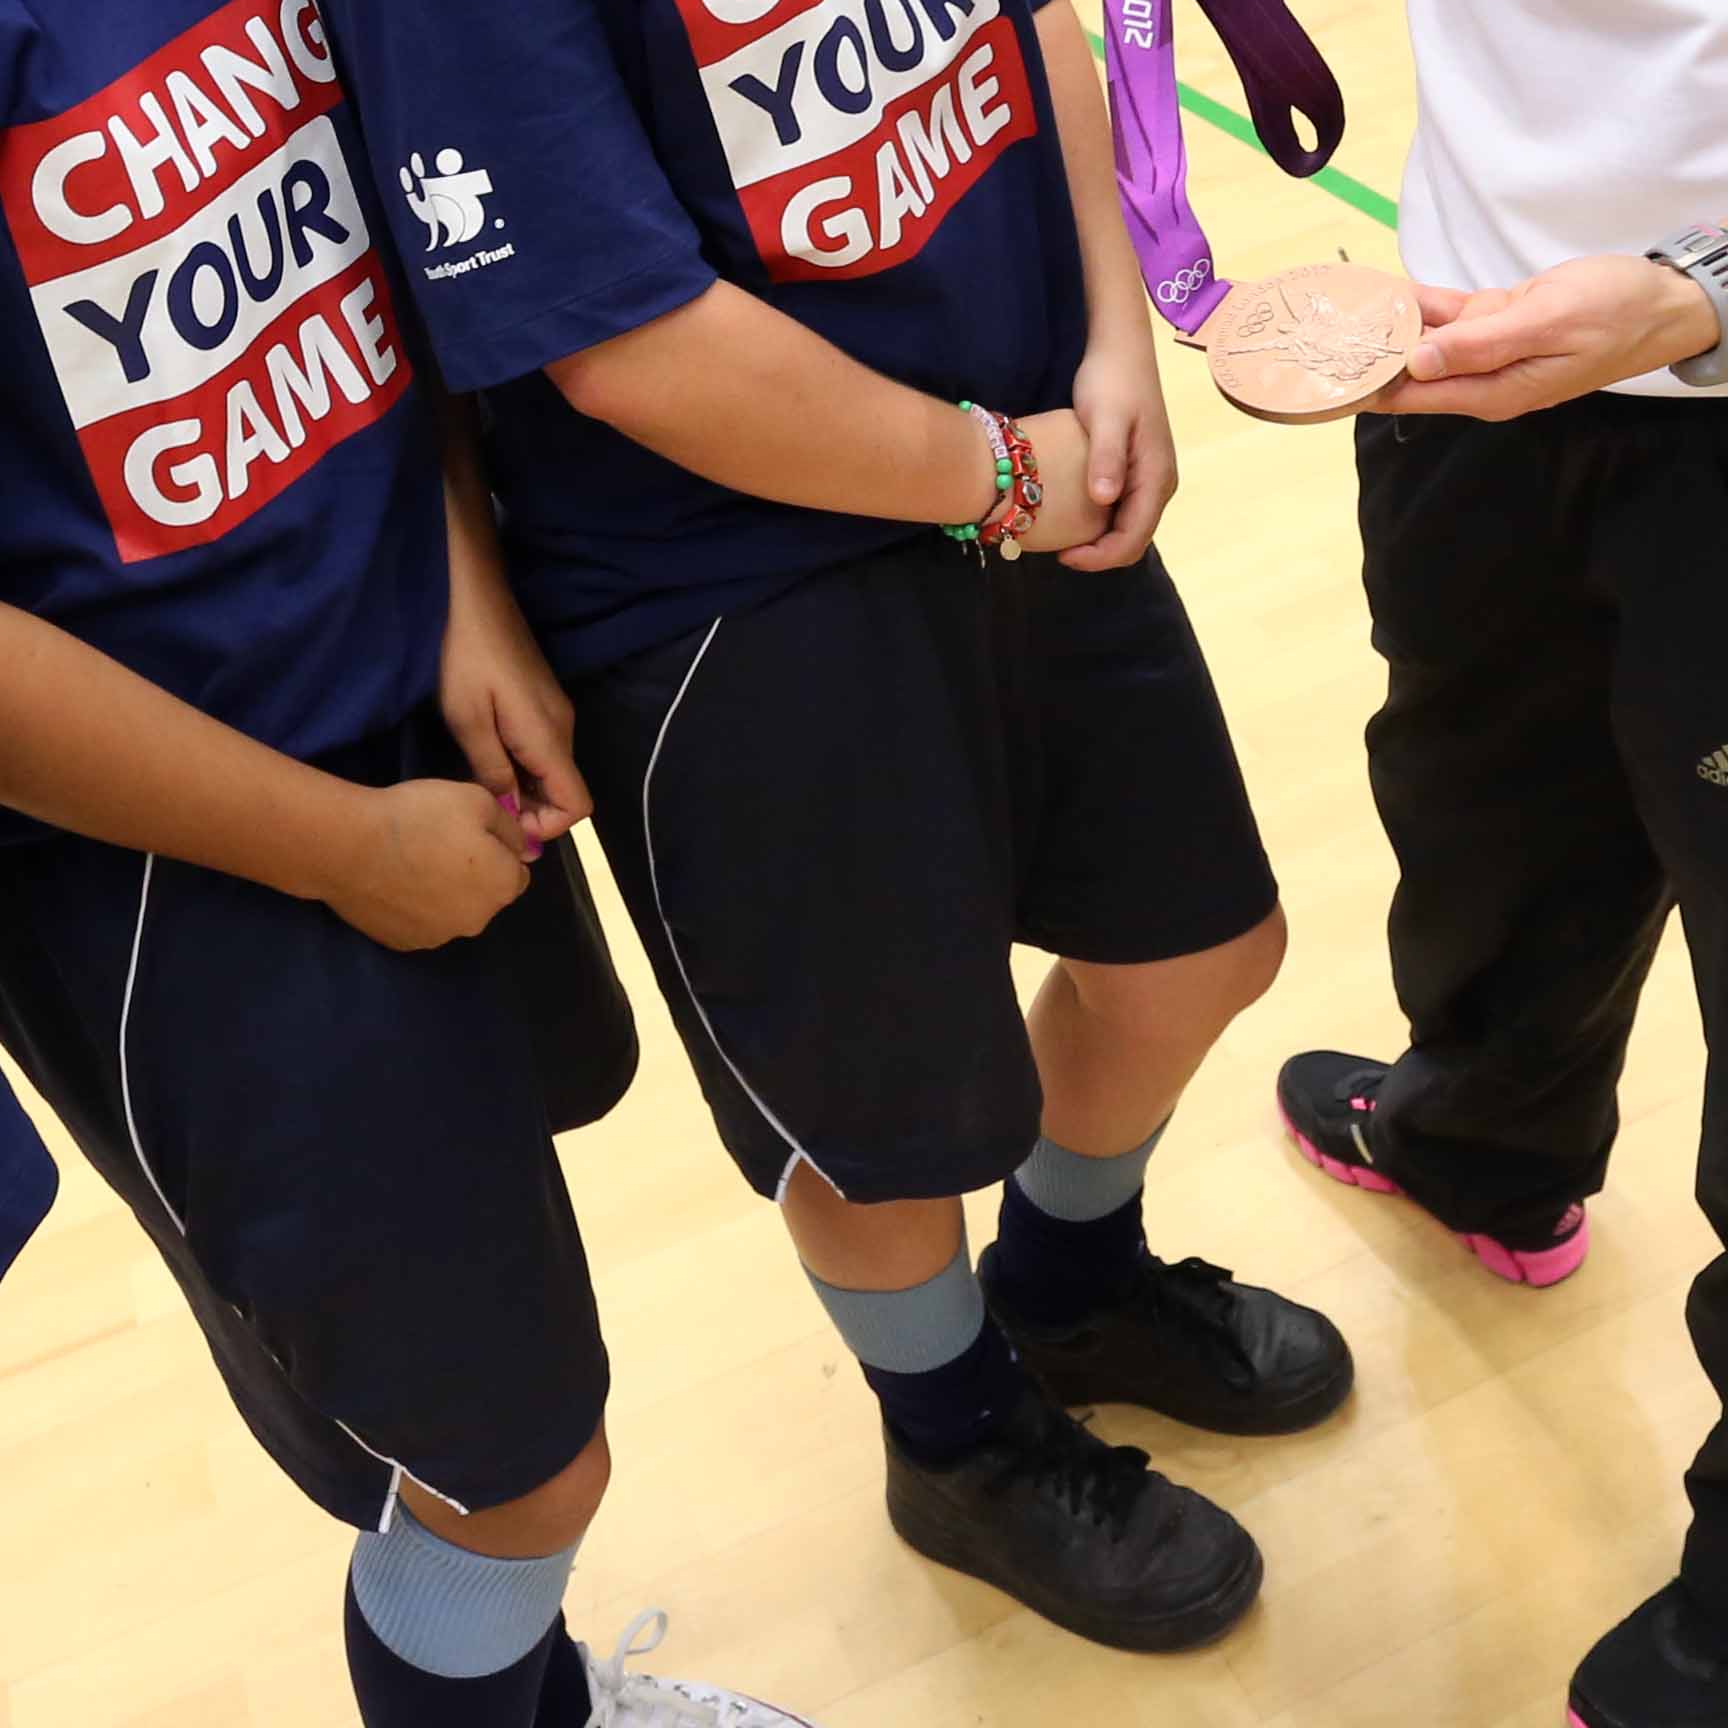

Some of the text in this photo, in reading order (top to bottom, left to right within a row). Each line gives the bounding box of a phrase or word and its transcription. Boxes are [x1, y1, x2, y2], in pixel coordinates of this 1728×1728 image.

[475, 243, 515, 266] Trust
[780, 42, 1012, 268] GAME
[62, 158, 350, 384] YOUR
[122, 276, 397, 528] GAME
